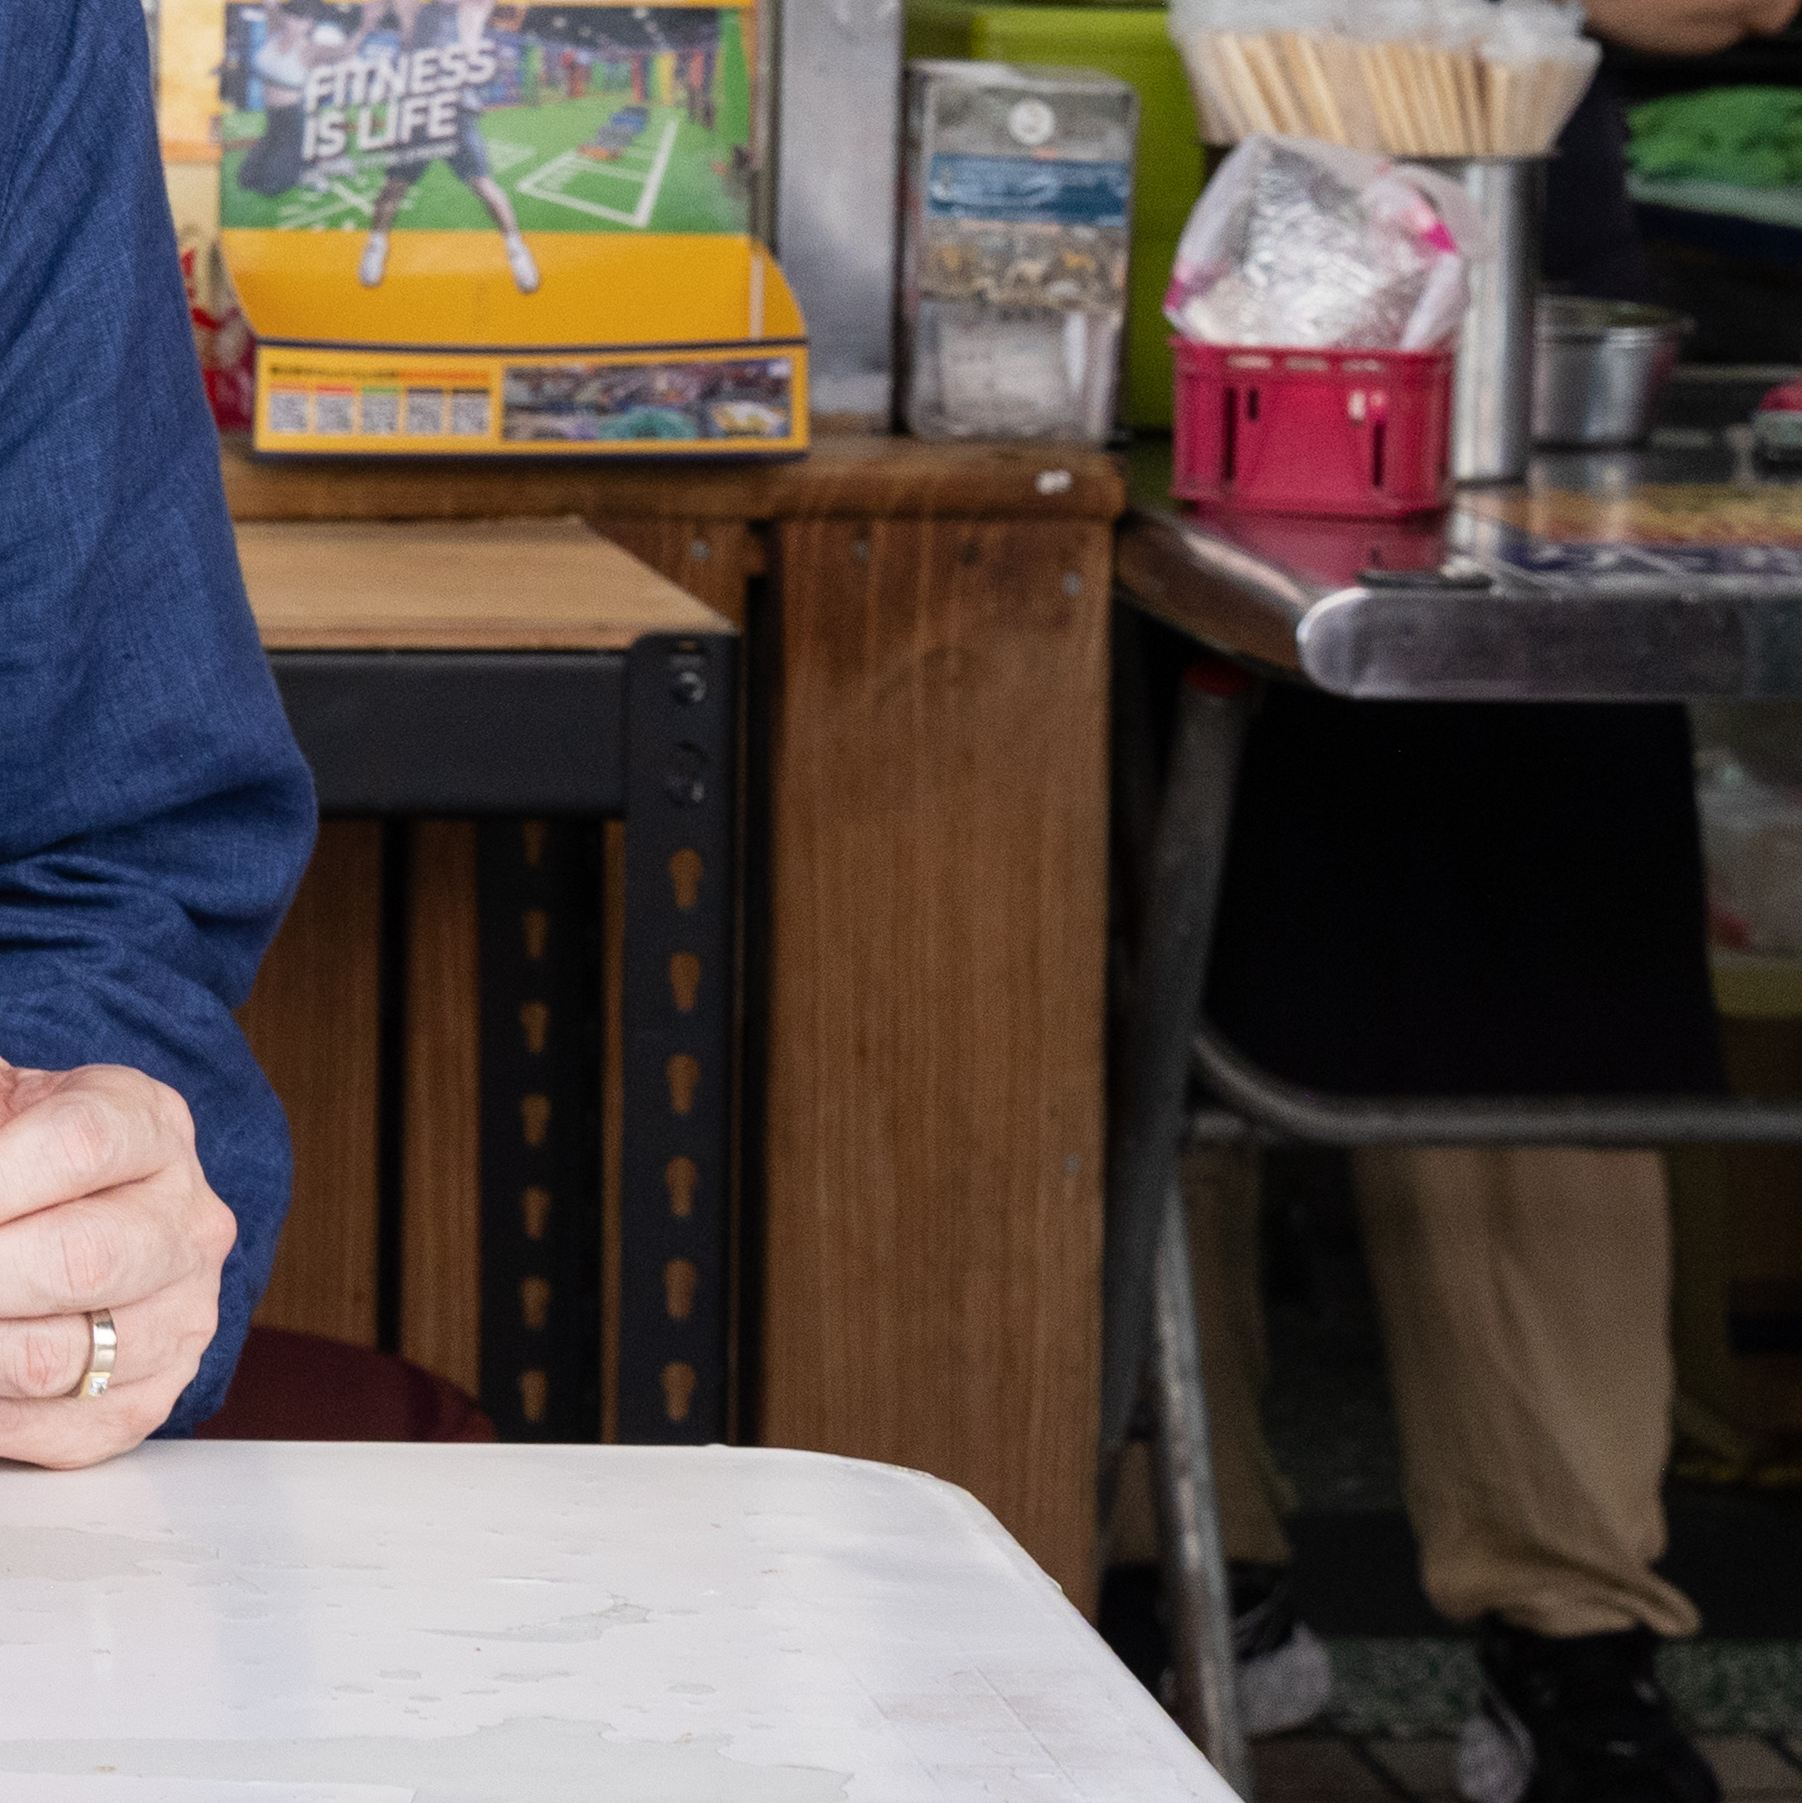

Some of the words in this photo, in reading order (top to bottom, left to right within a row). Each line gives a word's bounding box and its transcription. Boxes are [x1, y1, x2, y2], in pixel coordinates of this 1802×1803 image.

[305, 48, 496, 114] FITNESS
[303, 110, 346, 160] IS
[358, 91, 458, 149] LIFE
